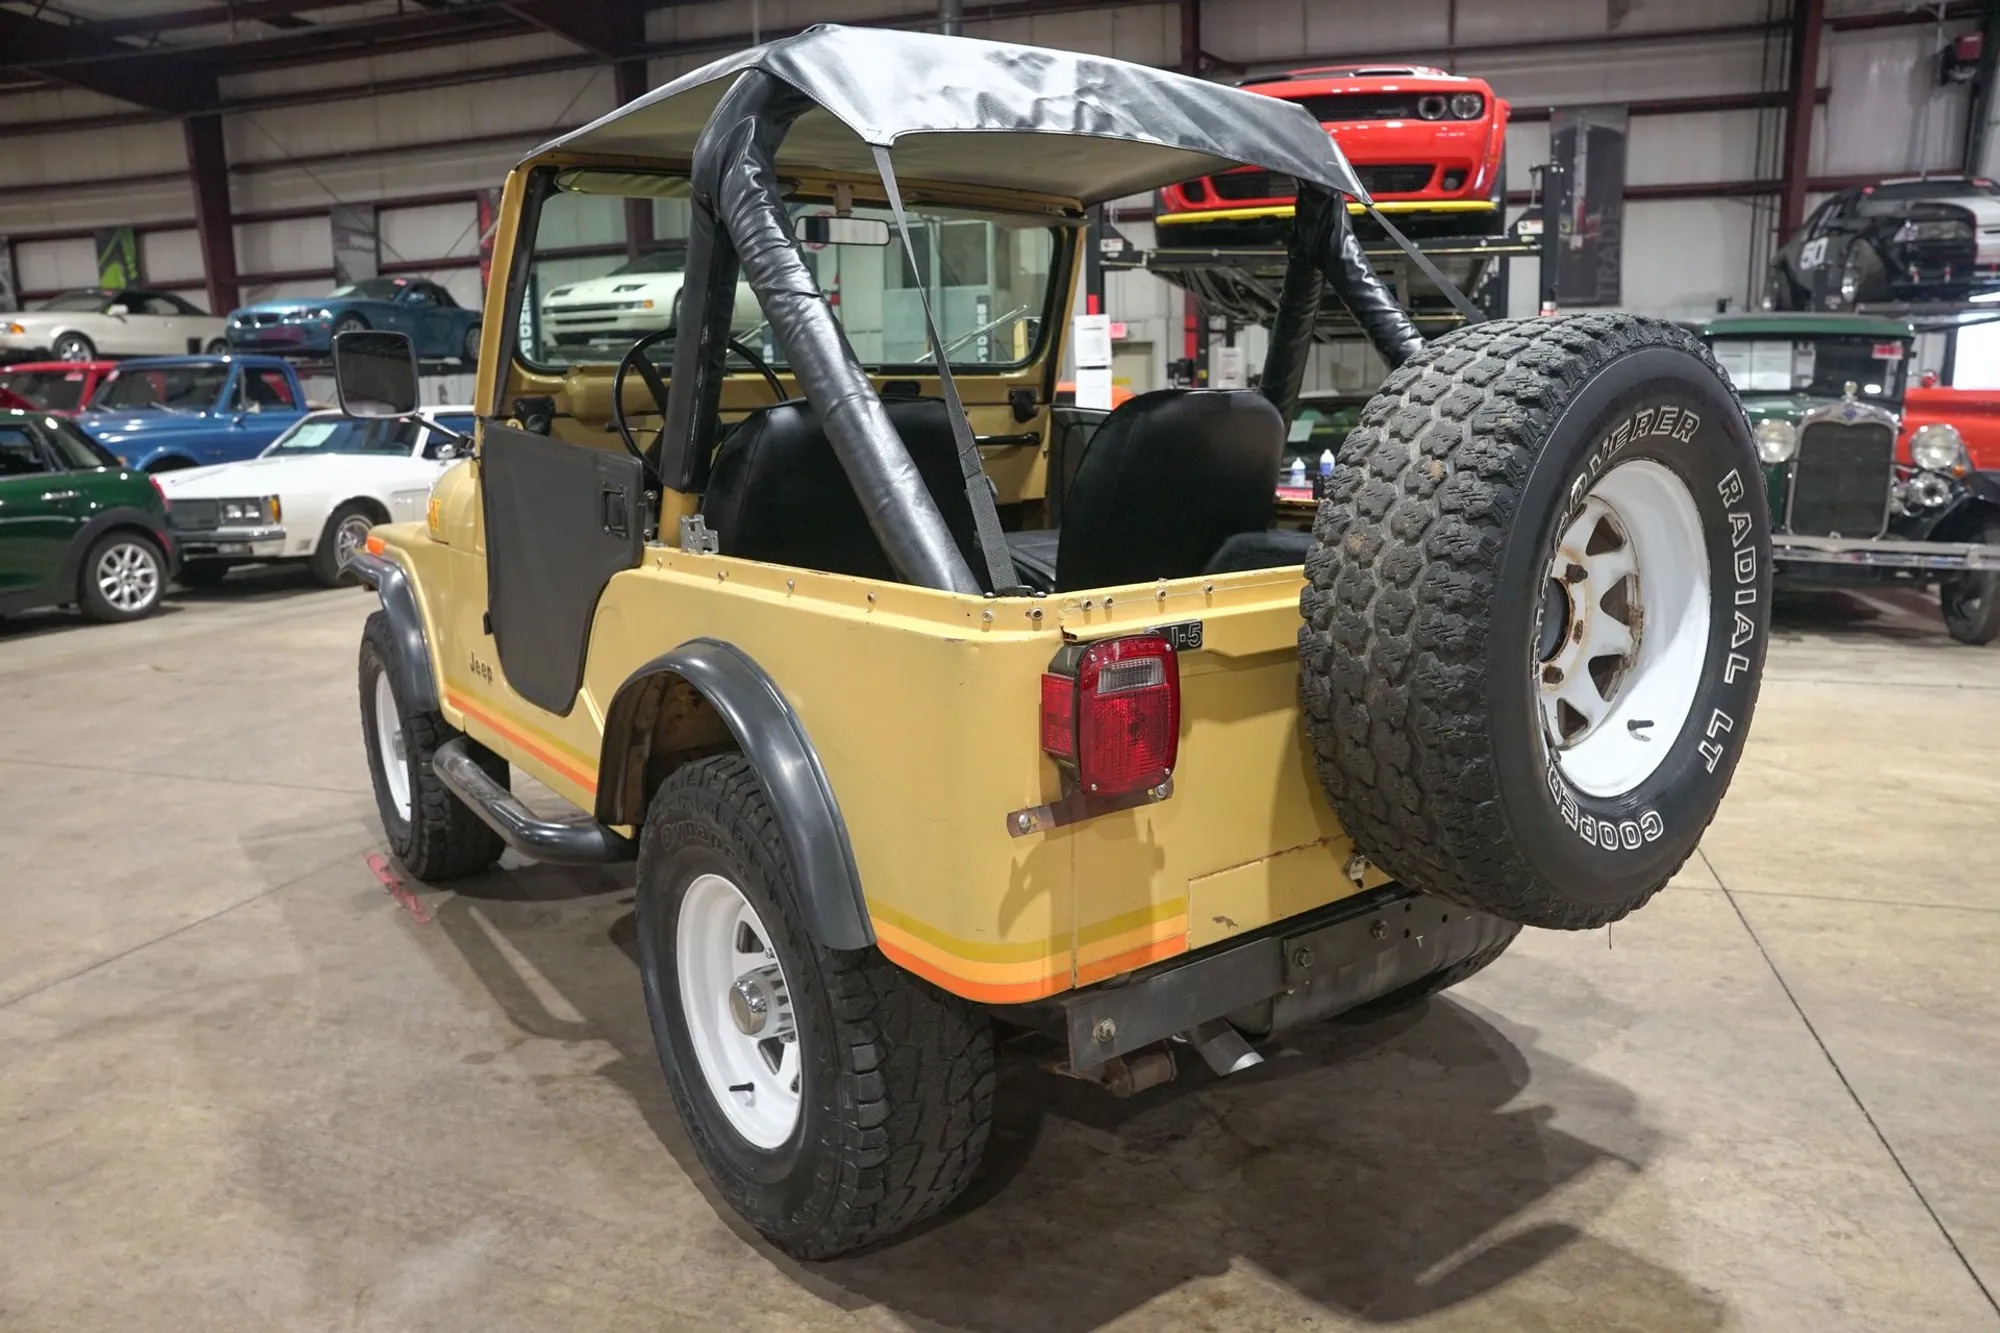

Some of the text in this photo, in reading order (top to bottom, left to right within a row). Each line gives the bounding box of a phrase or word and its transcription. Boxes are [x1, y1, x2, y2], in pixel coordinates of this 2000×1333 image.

[1146, 622, 1202, 648] J-5
[1698, 468, 1757, 774] RADIAL LT
[469, 650, 493, 686] Jeep
[1547, 766, 1664, 851] COOPER
